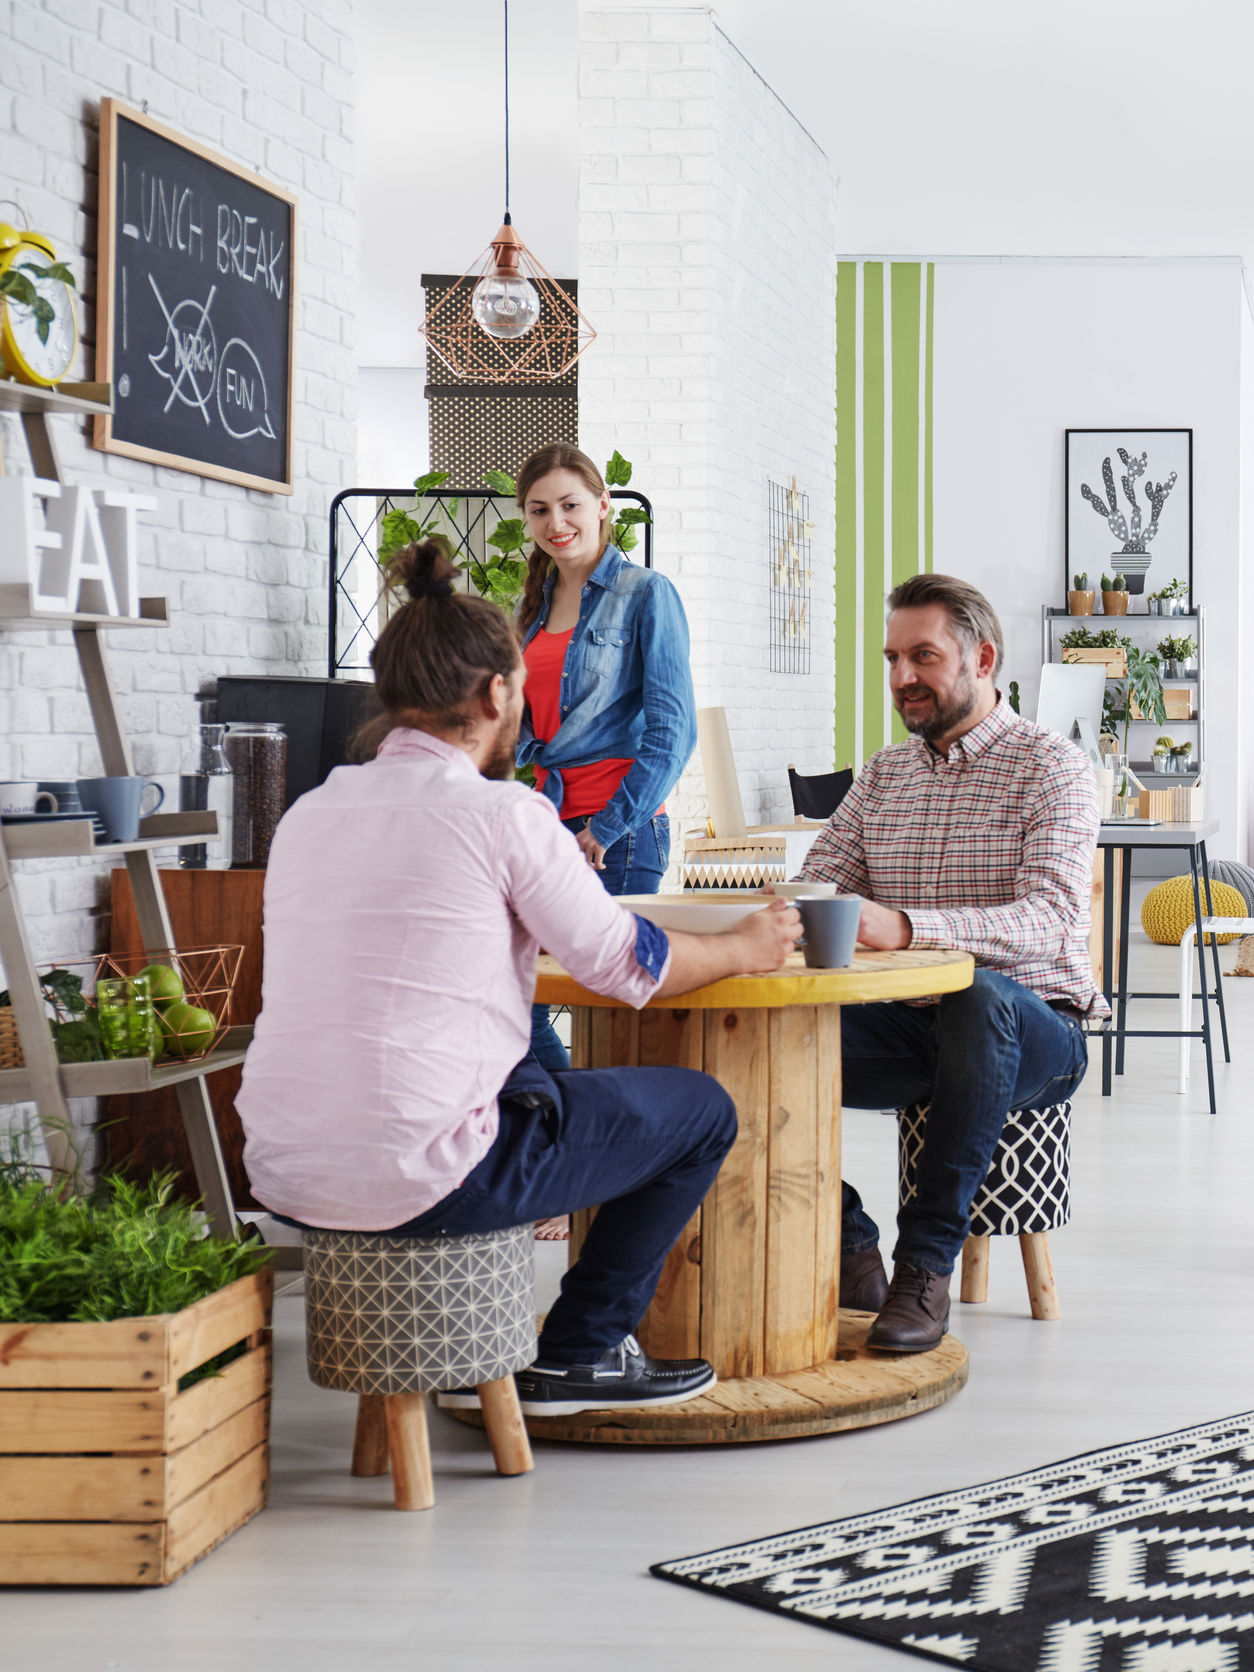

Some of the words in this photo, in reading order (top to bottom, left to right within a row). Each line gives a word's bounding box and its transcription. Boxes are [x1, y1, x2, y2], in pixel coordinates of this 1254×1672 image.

[122, 161, 203, 262] LUNCH
[217, 204, 284, 299] BREAK
[174, 328, 213, 373] WORK
[226, 368, 254, 412] FUN
[22, 476, 158, 619] EAT
